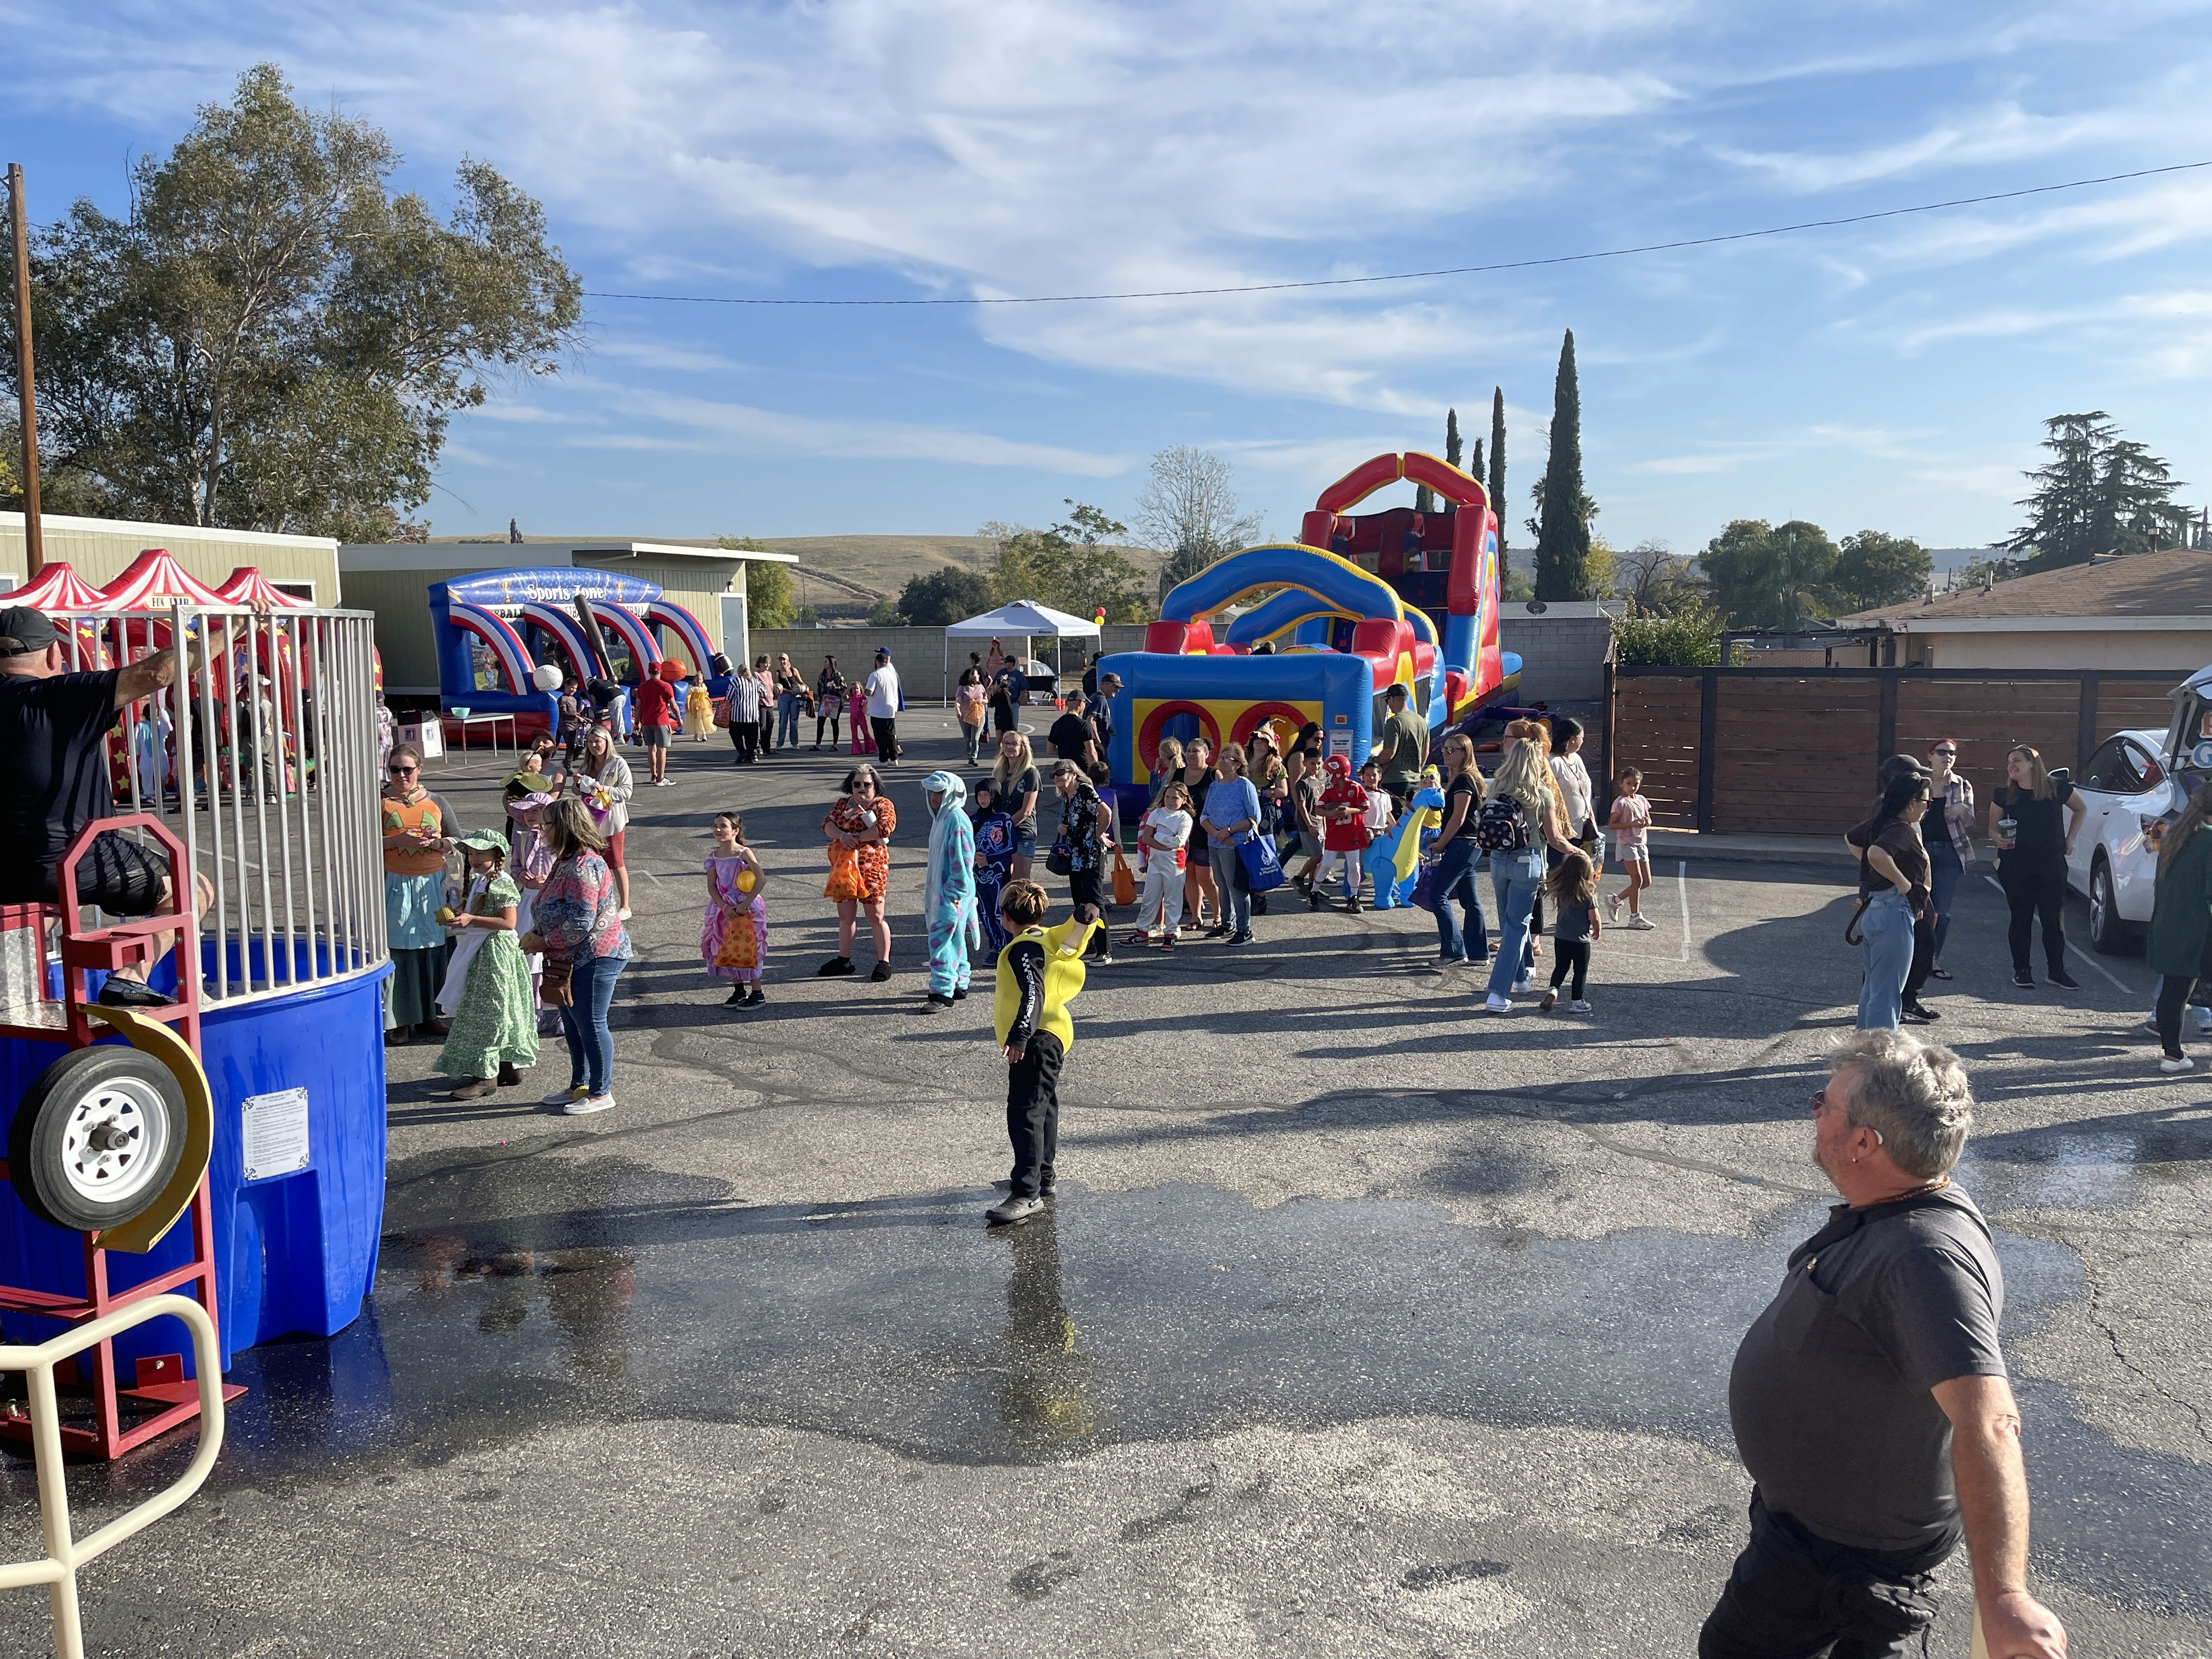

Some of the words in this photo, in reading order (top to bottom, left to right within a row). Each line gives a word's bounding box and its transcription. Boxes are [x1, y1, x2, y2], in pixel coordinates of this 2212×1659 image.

[527, 584, 571, 602] Sports
[574, 585, 604, 600] Zone
[152, 598, 164, 607] FUN
[169, 598, 189, 607] FAIR
